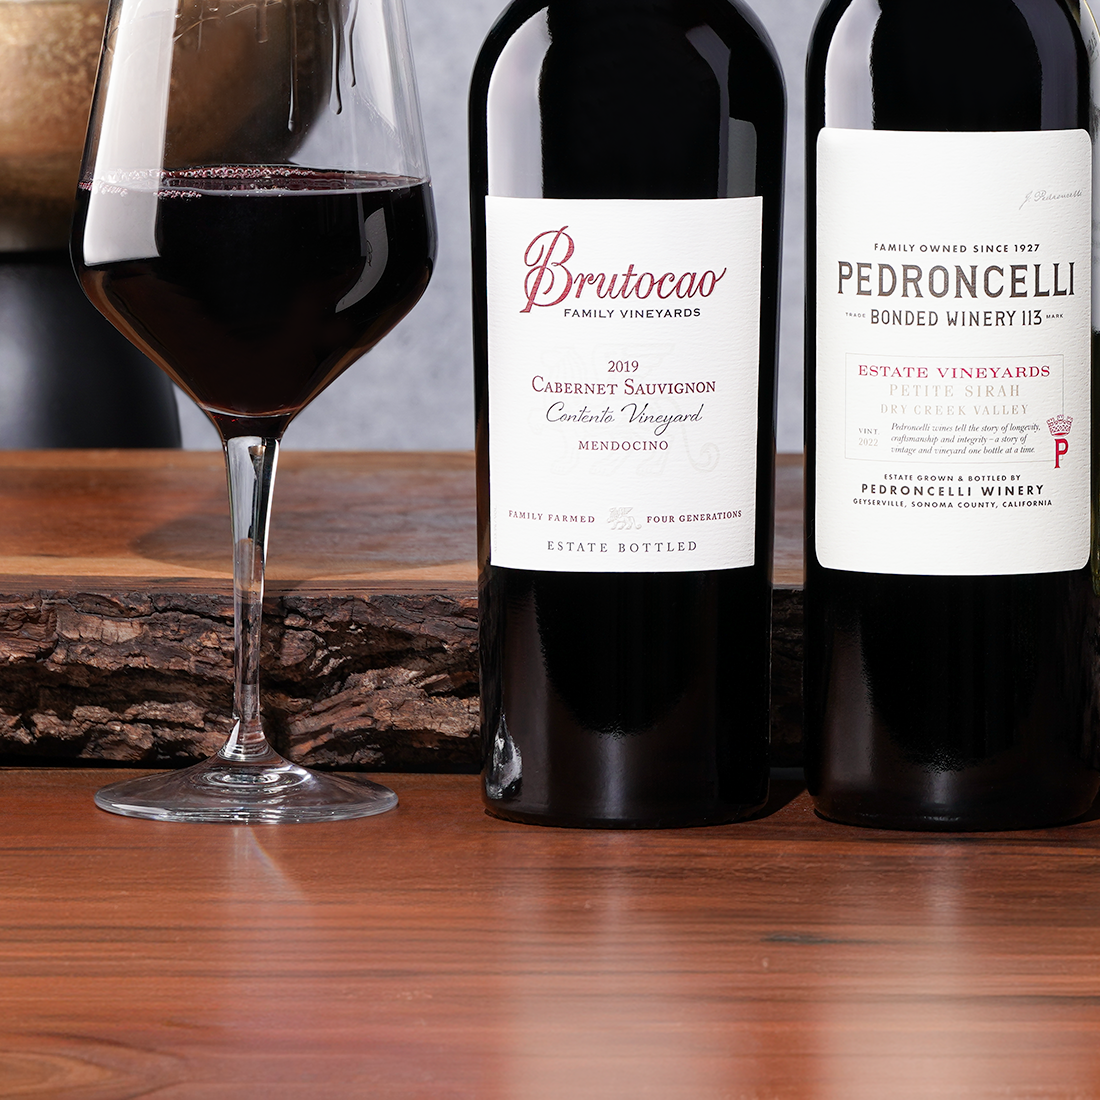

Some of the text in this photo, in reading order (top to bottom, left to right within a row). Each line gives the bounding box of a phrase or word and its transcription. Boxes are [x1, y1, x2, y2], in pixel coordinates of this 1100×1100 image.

[874, 243, 1040, 253] FAMILY OWNED SINCE 1927
[519, 225, 727, 313] Brutocao
[837, 260, 1075, 299] PEDRONCELLI
[564, 308, 701, 319] FAMILY VINEYARDS
[870, 309, 939, 327] BONDED
[946, 309, 1016, 327] WINERY
[1021, 309, 1042, 326] 113
[607, 360, 639, 373] 2019
[858, 364, 1050, 379] ESTATE VINEYARDS
[889, 384, 1020, 398] PETITE SIRAH
[880, 403, 1029, 416] DRY CREEK VALLEY
[546, 401, 705, 436] Contento Vineyard
[891, 422, 931, 432] Pedroncelli
[954, 423, 965, 432] tell
[966, 423, 979, 432] the
[981, 424, 999, 434] story
[1000, 423, 1010, 434] of
[578, 440, 669, 451] MENDOCINO
[858, 438, 879, 447] 2022
[891, 434, 939, 445] craftsmanship
[940, 435, 955, 443] and
[957, 435, 988, 445] integrity
[1001, 436, 1019, 445] story
[1019, 434, 1028, 445] of
[891, 446, 916, 455] vintage
[918, 446, 931, 454] and
[934, 446, 966, 457] vineyard
[983, 446, 1003, 454] bottle
[1054, 438, 1069, 468] P
[884, 473, 913, 481] ESTATE
[861, 483, 1044, 497] PEDRONCELLI WINERY
[853, 498, 1052, 509] GEYSERVILLE, SONOMA COUNTY, CALIFORNIA
[508, 510, 742, 523] FAMILY FARMED FOUR GENERATIONS
[547, 540, 697, 553] ESTATE BOTTLED
